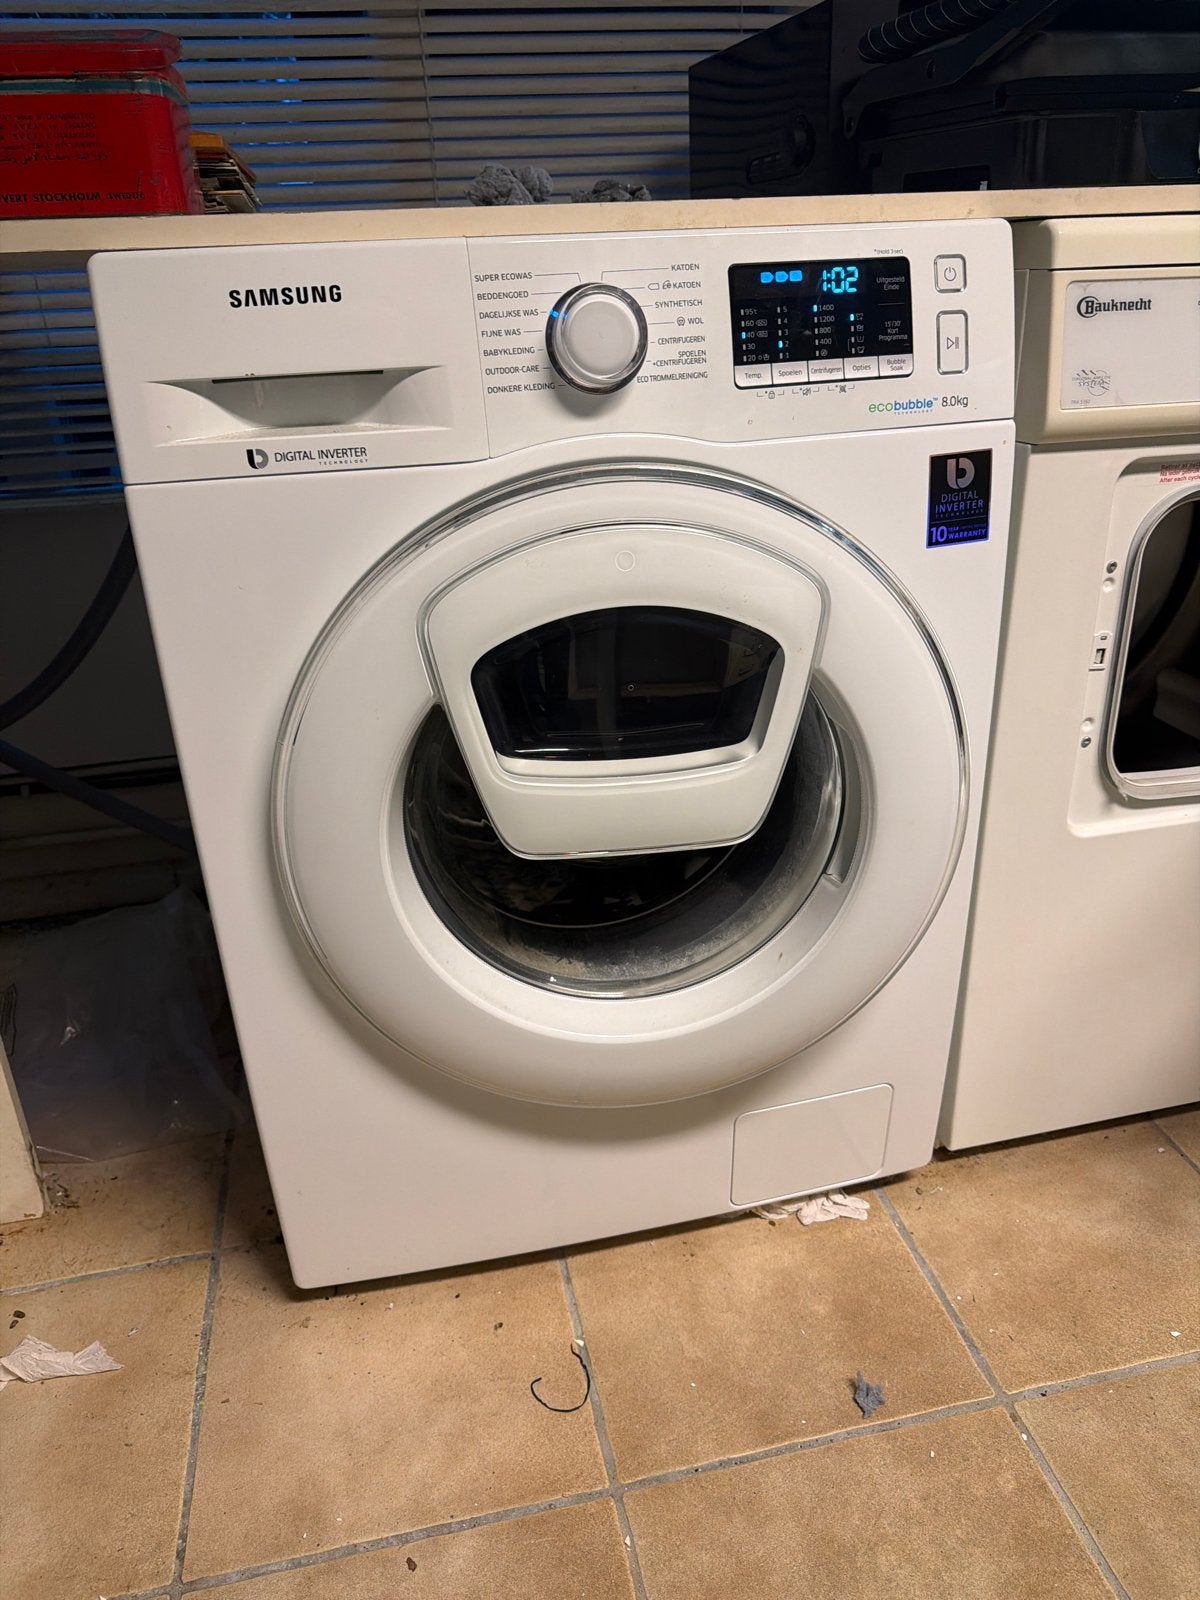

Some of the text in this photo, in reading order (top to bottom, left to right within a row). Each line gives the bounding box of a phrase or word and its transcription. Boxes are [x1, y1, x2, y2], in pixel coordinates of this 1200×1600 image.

[32, 192, 100, 202] STOCKHOLM
[671, 264, 700, 272] KATOEN
[474, 272, 533, 282] SUPER ECOWAS
[822, 266, 859, 294] 1:02
[876, 276, 905, 284] Uitgesteld
[673, 281, 702, 289] KATOEN
[228, 284, 342, 308] SAMSUNG
[477, 290, 529, 300] BEDDENGOED
[655, 300, 703, 308] SYNTHETISCH
[1077, 296, 1152, 318] Bauknecht
[479, 308, 539, 320] DAGELIJKSE WAS
[481, 328, 522, 338] FIJNE WAS
[878, 334, 908, 342] Programma
[658, 336, 706, 346] CENTRIFUGEREN
[483, 346, 536, 356] BABYKLEDING
[678, 350, 706, 358] SPOELEN
[886, 358, 906, 366] Bubble
[485, 365, 540, 376] OUTDOOR-CARE
[778, 369, 802, 377] Spoelen
[810, 366, 842, 374] Centrifugeren
[852, 364, 872, 372] Opties
[890, 364, 904, 372] Soak
[636, 371, 708, 384] ECO TROMMELREINIGING
[487, 382, 556, 394] DONKERE KLEDING
[941, 396, 969, 408] 8.0kg
[274, 447, 368, 462] DIGITAL INVERTER
[318, 458, 369, 466] TECHNOLOGY
[941, 490, 978, 503] DIGITAL
[936, 499, 984, 514] INVERTER
[930, 526, 948, 543] 10
[948, 528, 986, 540] WARRANTY
